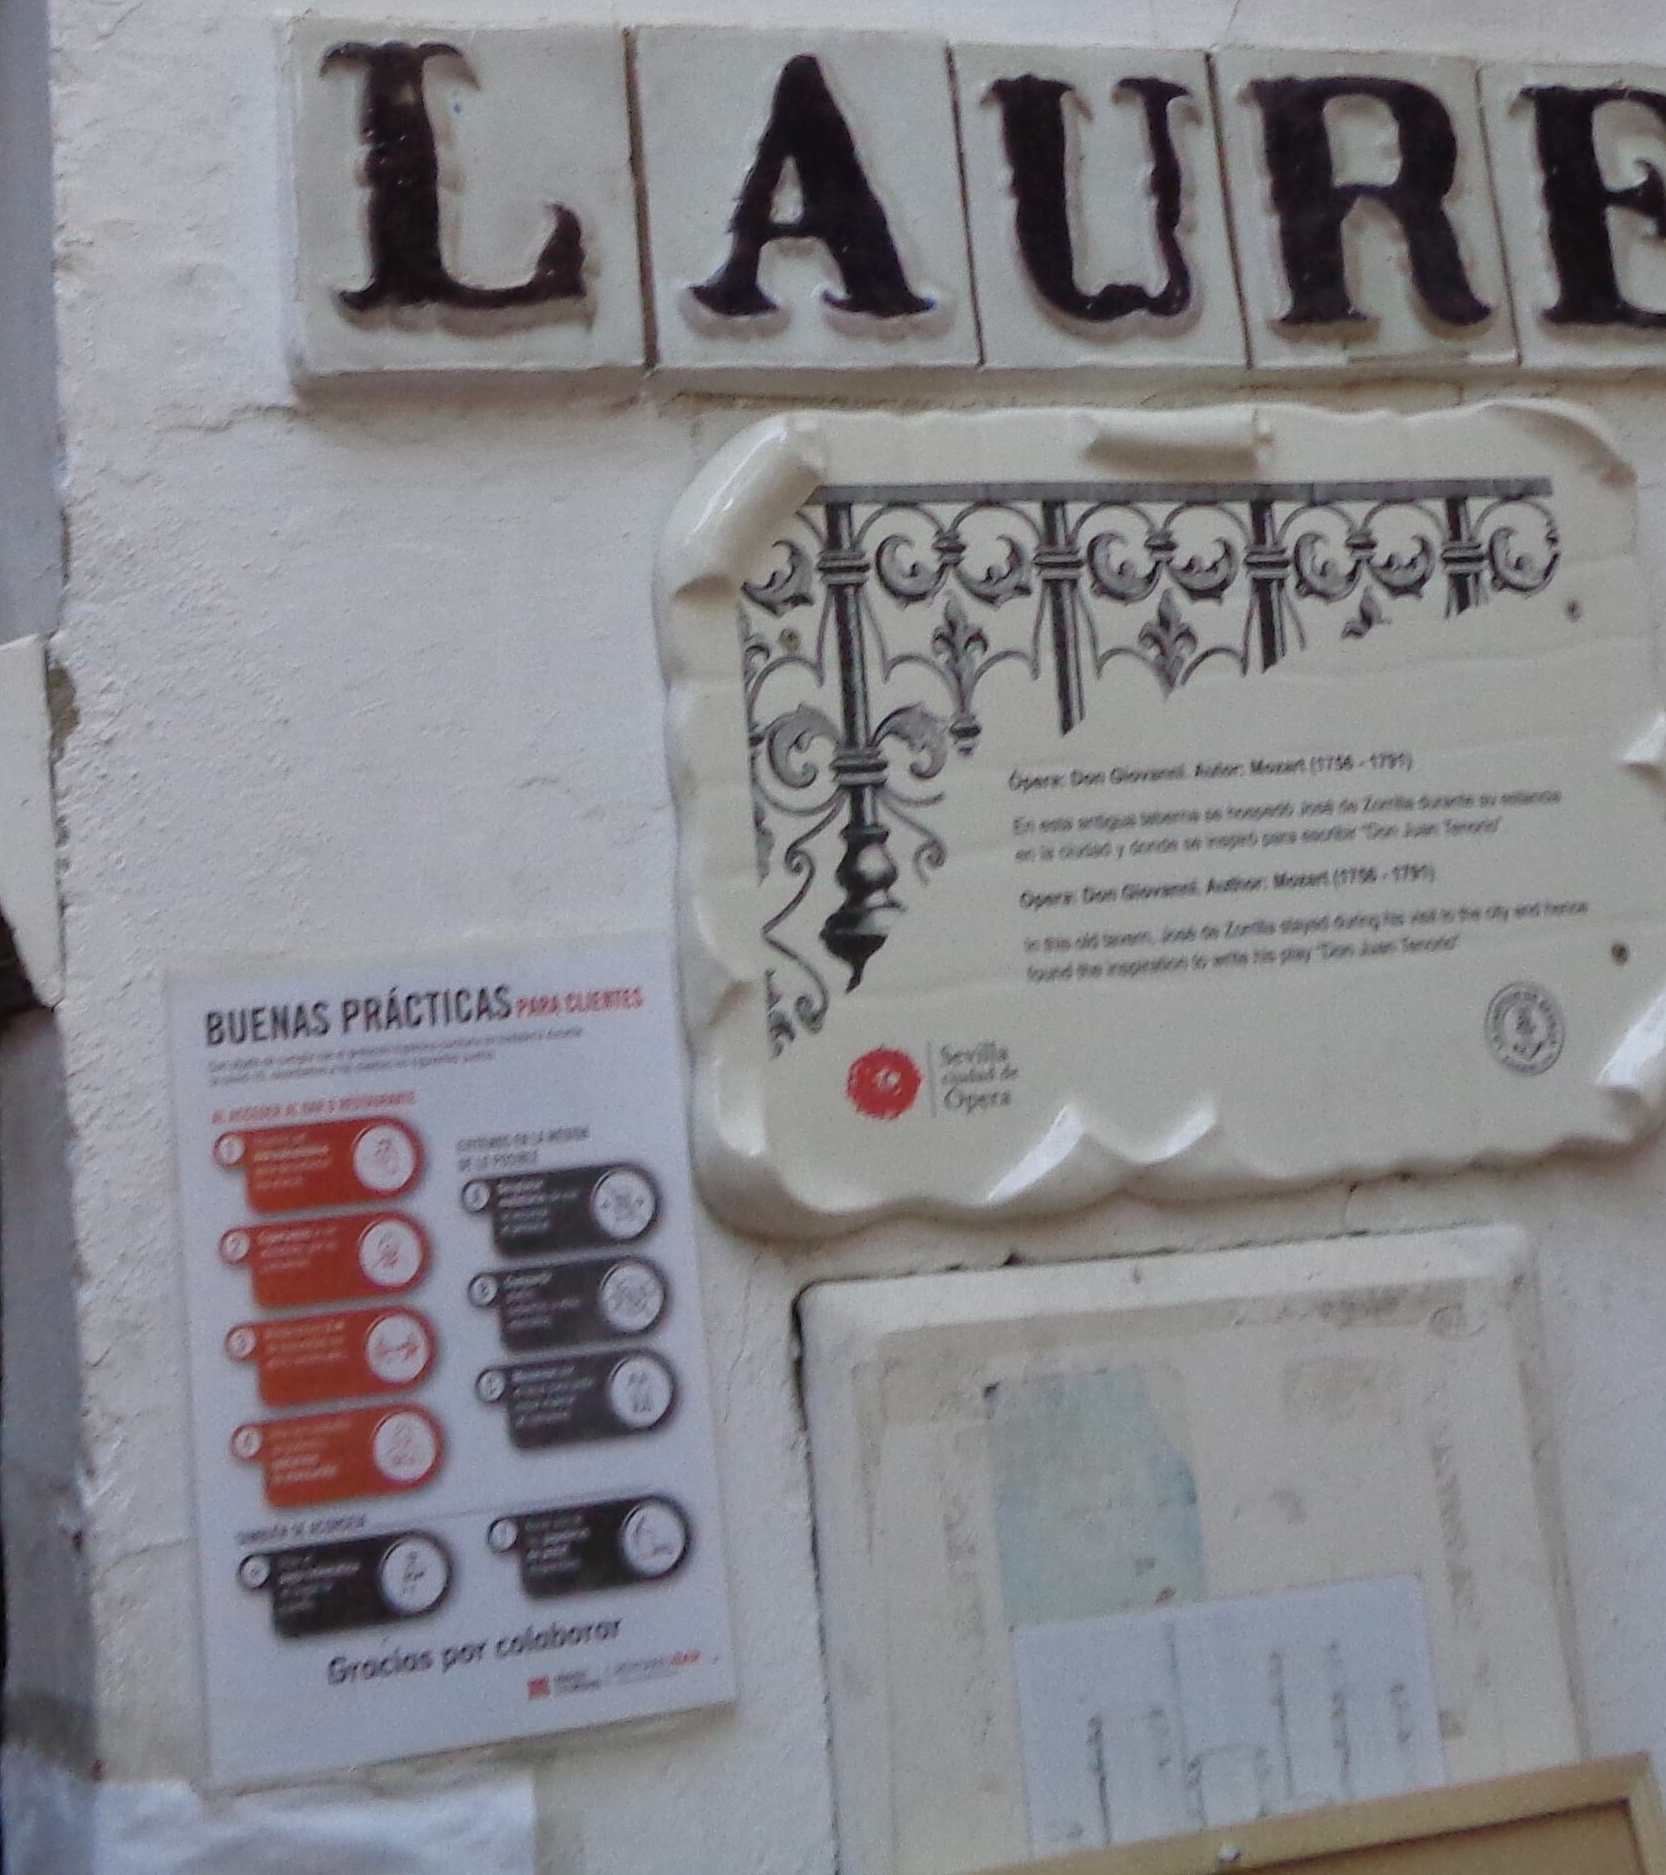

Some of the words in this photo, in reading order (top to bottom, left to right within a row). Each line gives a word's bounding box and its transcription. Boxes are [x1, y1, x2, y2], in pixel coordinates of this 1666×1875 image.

[1070, 768, 1105, 787] Don
[1250, 757, 1306, 774] Mozart
[1083, 886, 1118, 905] Don
[1273, 870, 1329, 889] Mozart
[205, 998, 332, 1049] BUENAS
[339, 985, 514, 1037] PRÁCTICAS
[940, 1039, 1010, 1066] Sevilla
[326, 1644, 433, 1687] Gracias
[439, 1638, 487, 1673] por
[494, 1617, 624, 1661] colaborar
